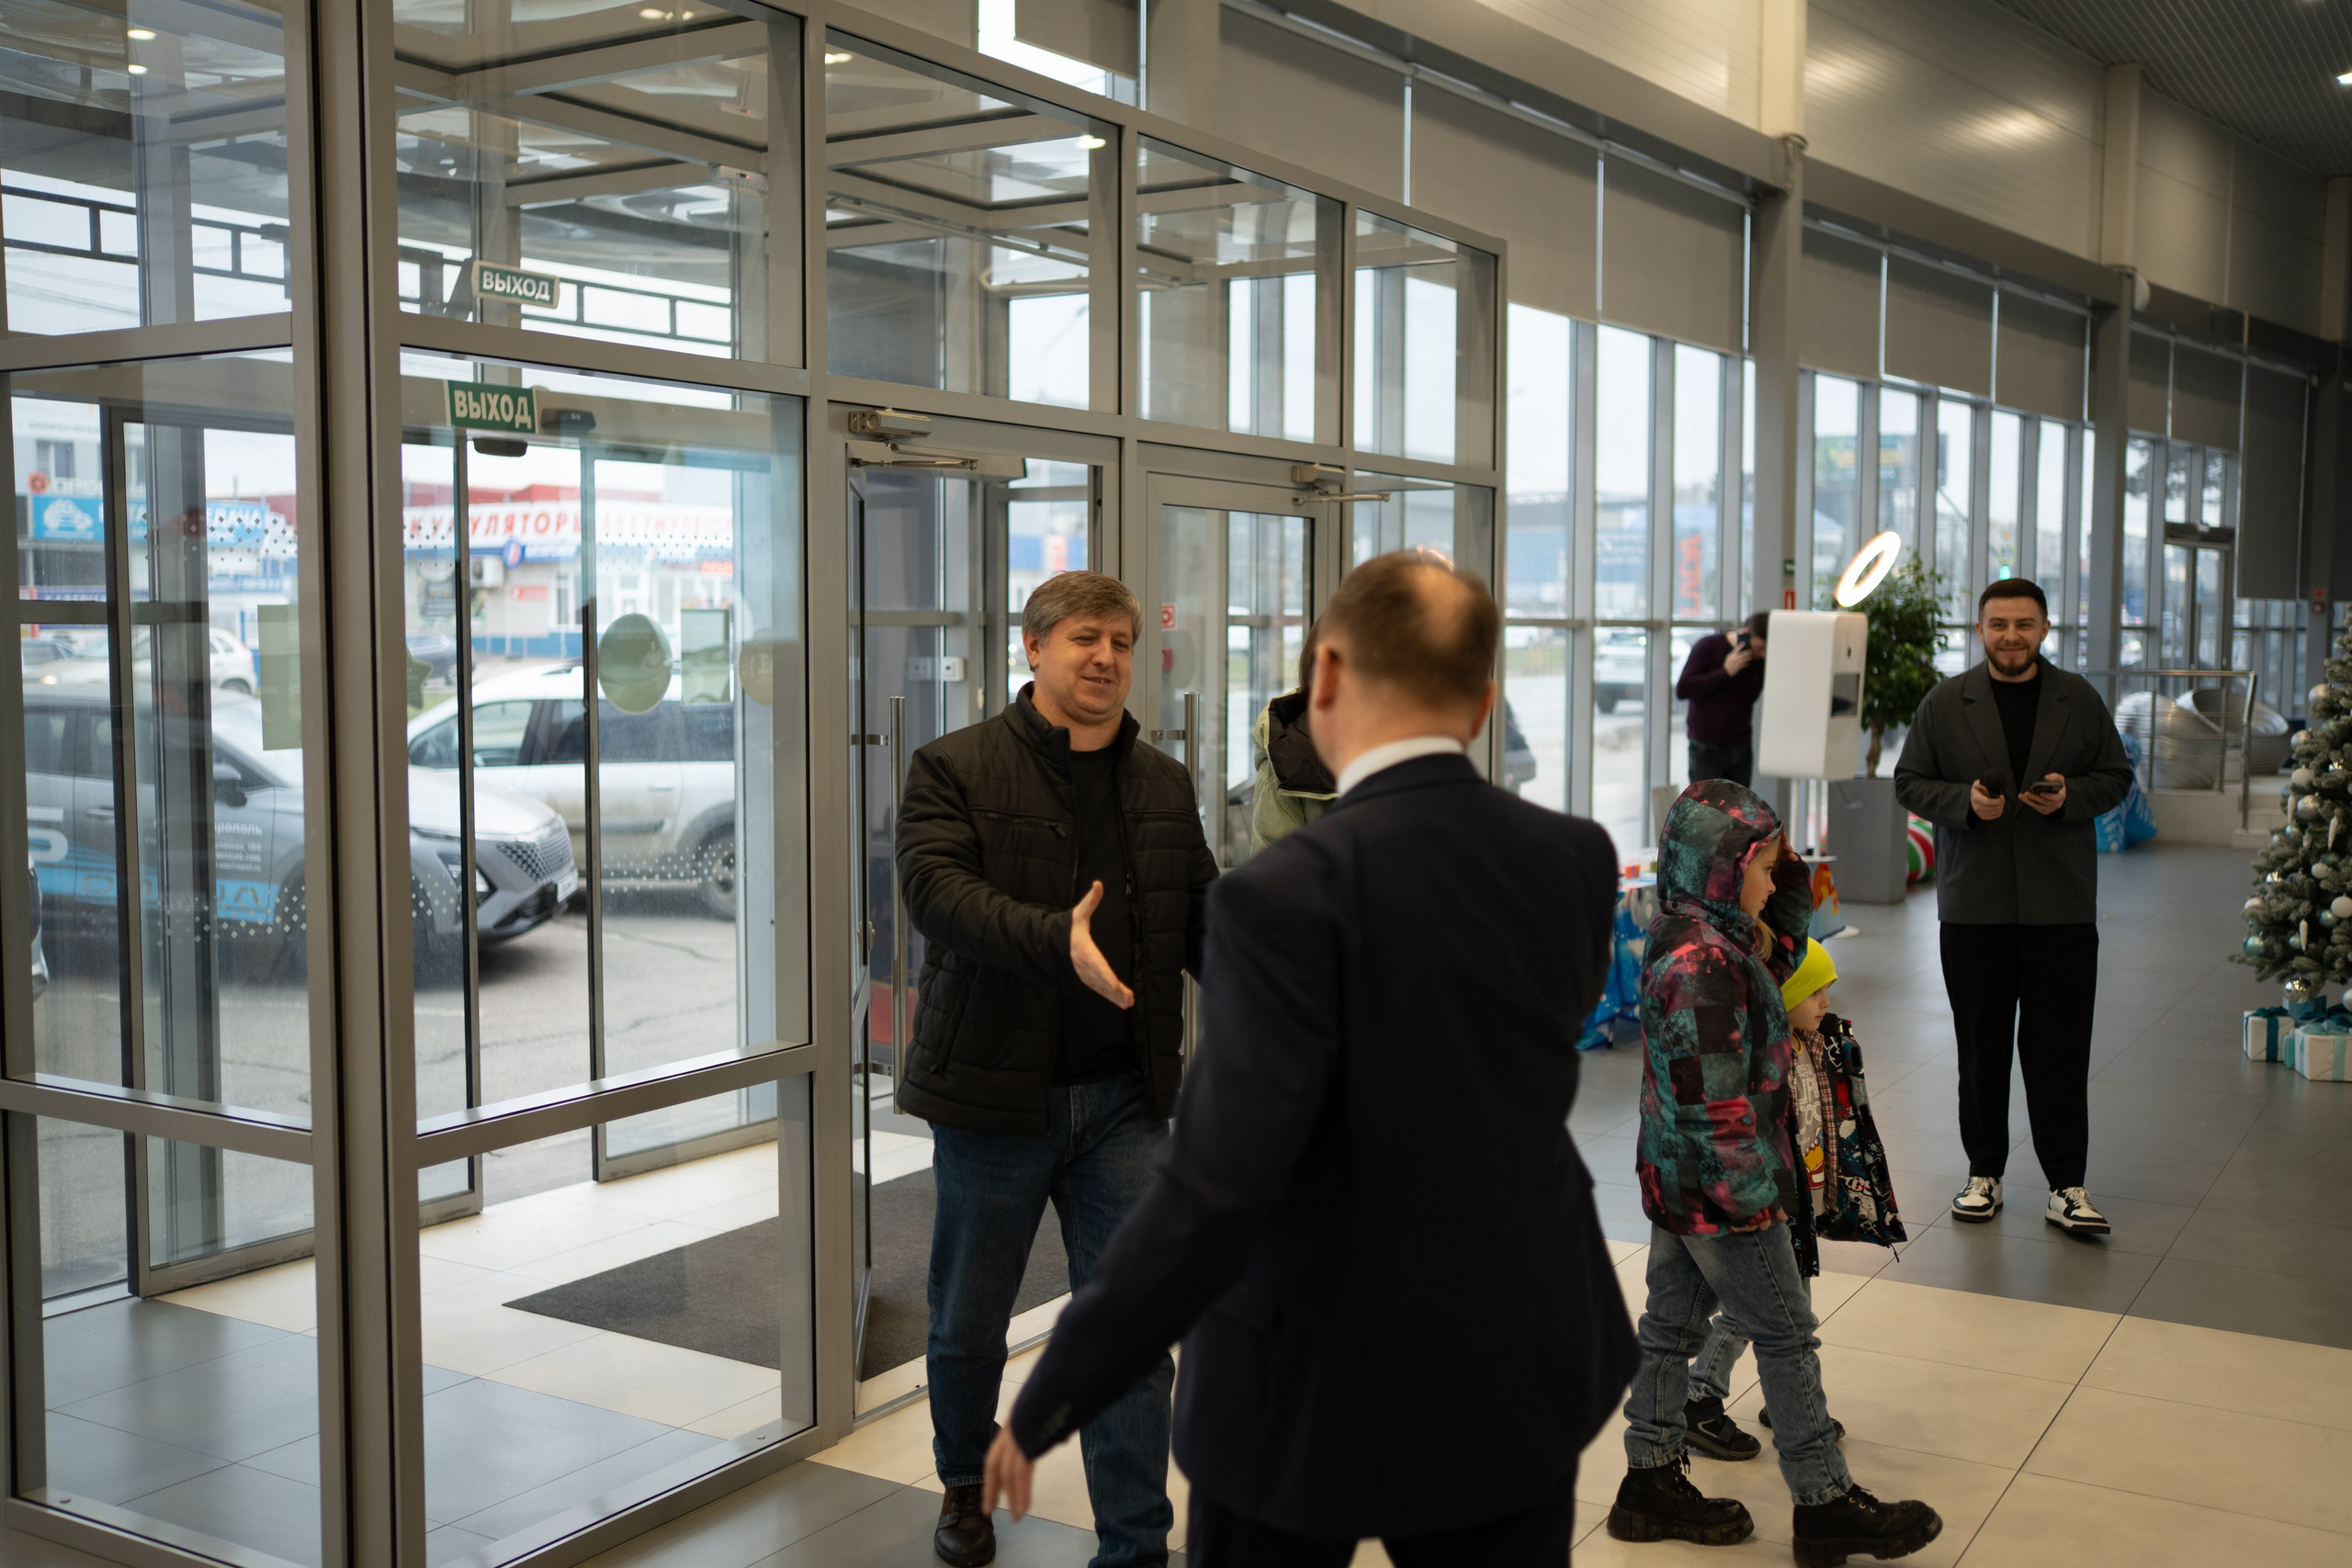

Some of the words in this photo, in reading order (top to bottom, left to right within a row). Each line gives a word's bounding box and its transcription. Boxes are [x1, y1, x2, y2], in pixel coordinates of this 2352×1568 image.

[482, 270, 550, 301] ВЫХОД
[454, 389, 533, 429] ВЫХОД
[215, 821, 263, 835] рополь
